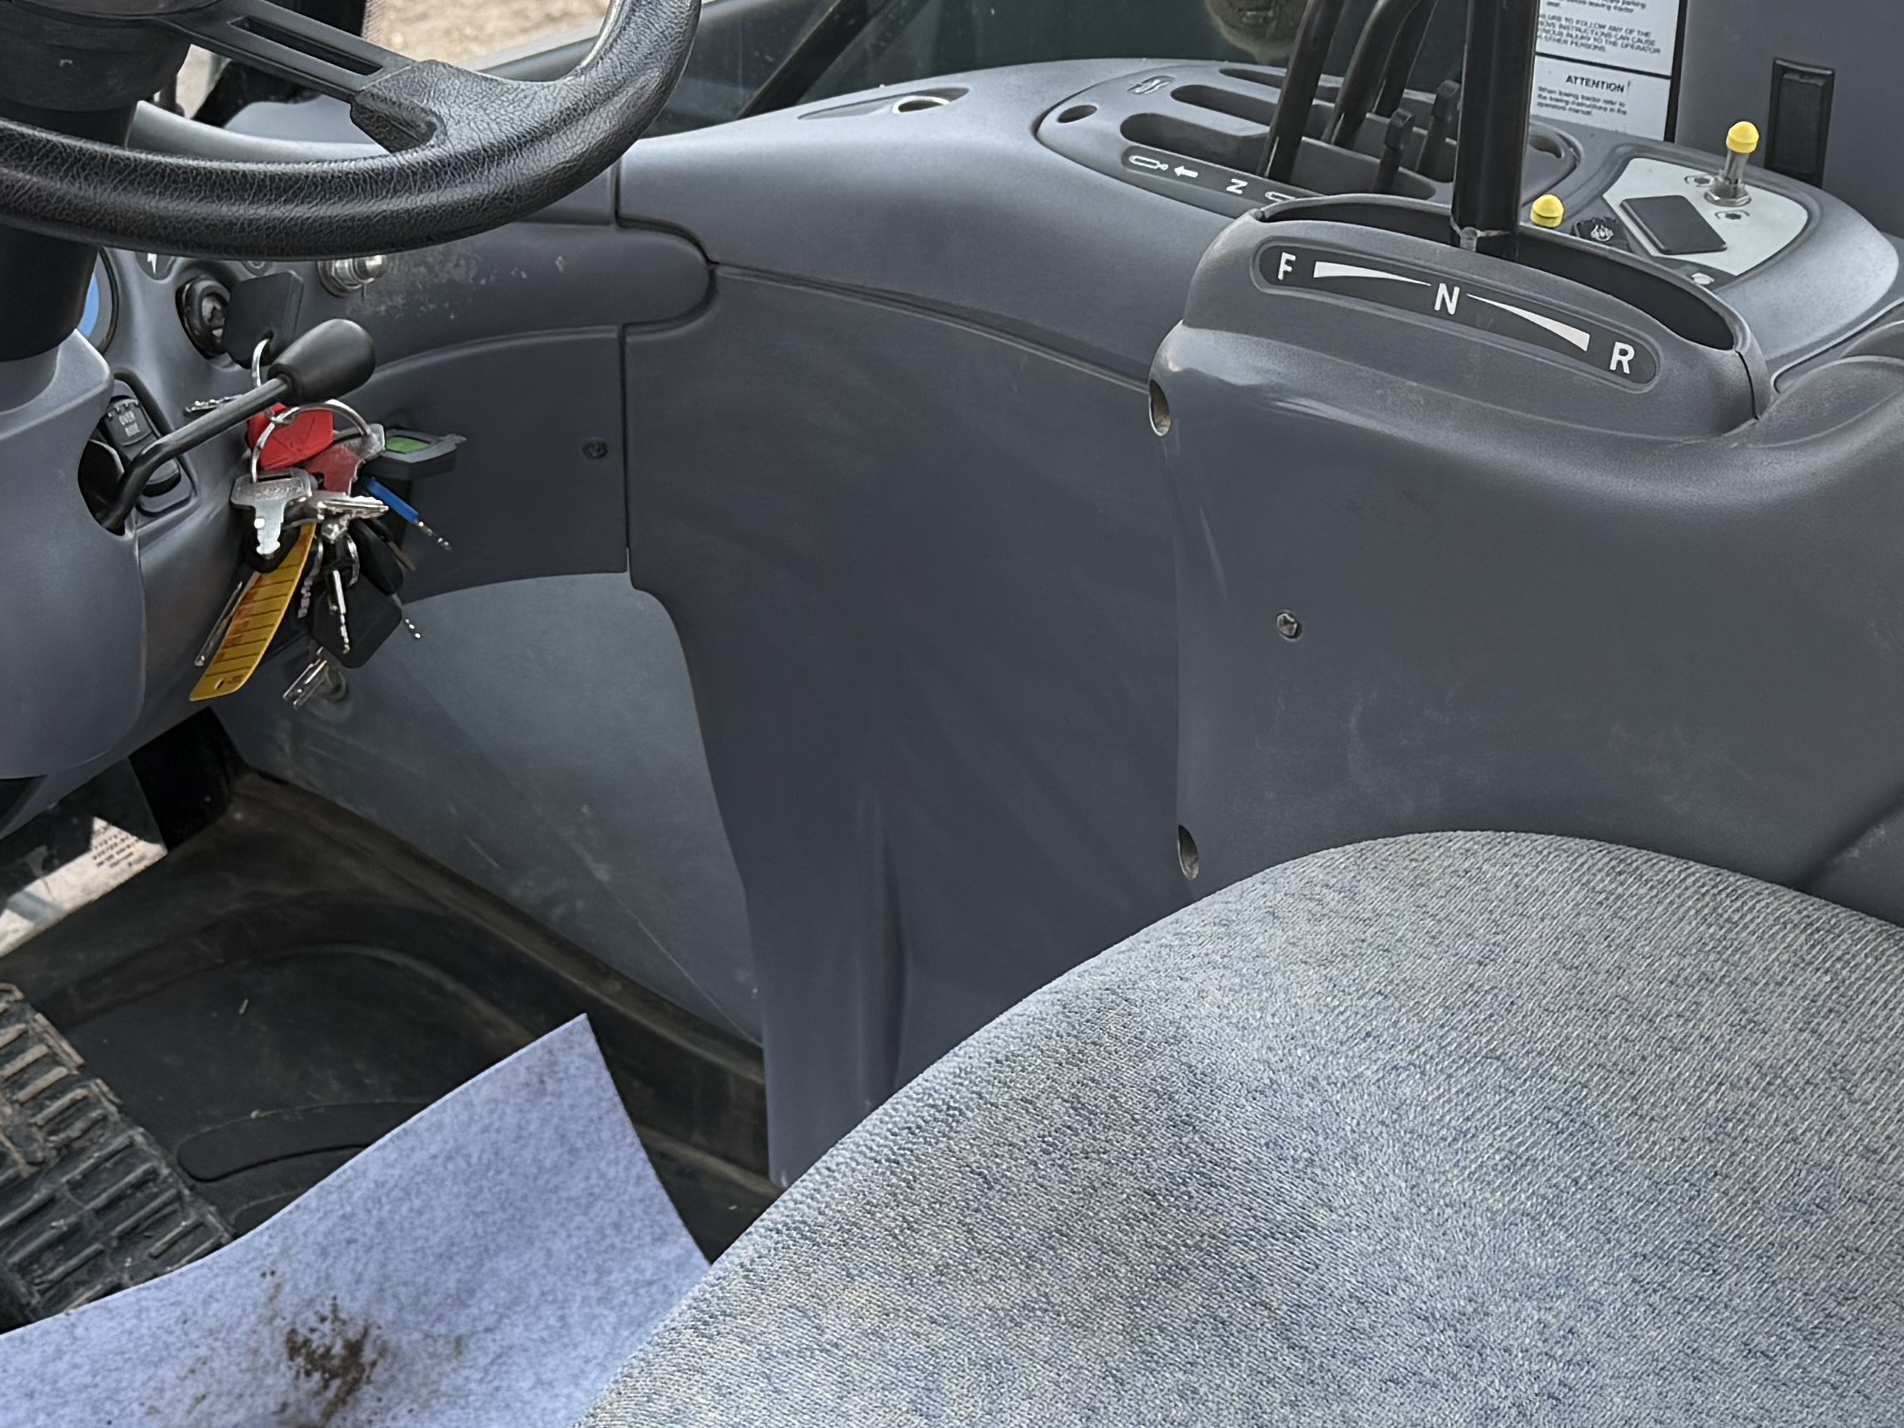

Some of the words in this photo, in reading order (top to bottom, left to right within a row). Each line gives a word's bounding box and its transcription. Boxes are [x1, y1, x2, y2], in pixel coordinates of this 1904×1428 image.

[1565, 74, 1625, 93] ATTENTION
[1277, 251, 1296, 280] F
[1434, 282, 1460, 315] N
[1609, 341, 1635, 374] R
